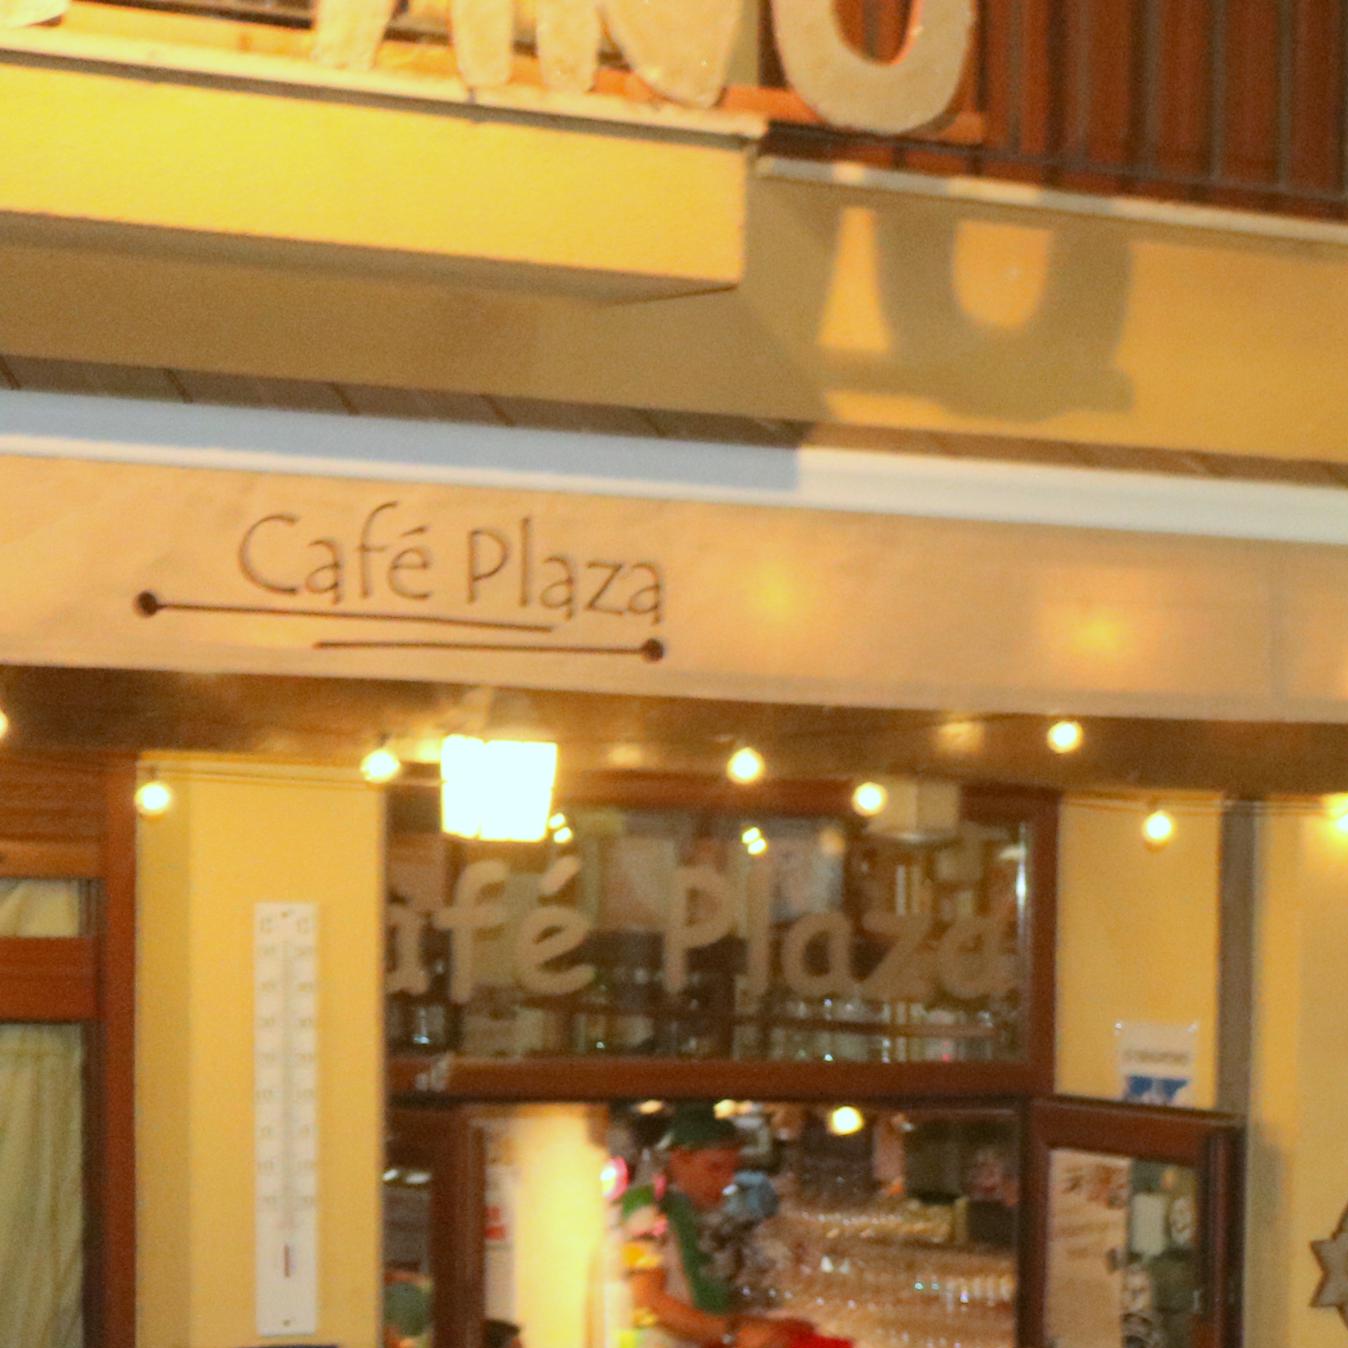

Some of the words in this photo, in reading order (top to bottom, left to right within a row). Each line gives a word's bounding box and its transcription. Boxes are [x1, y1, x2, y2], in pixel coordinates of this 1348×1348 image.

[238, 500, 433, 606] Café
[466, 515, 666, 625] Plaza
[386, 855, 596, 1003] afé
[663, 865, 1016, 1000] Plaza
